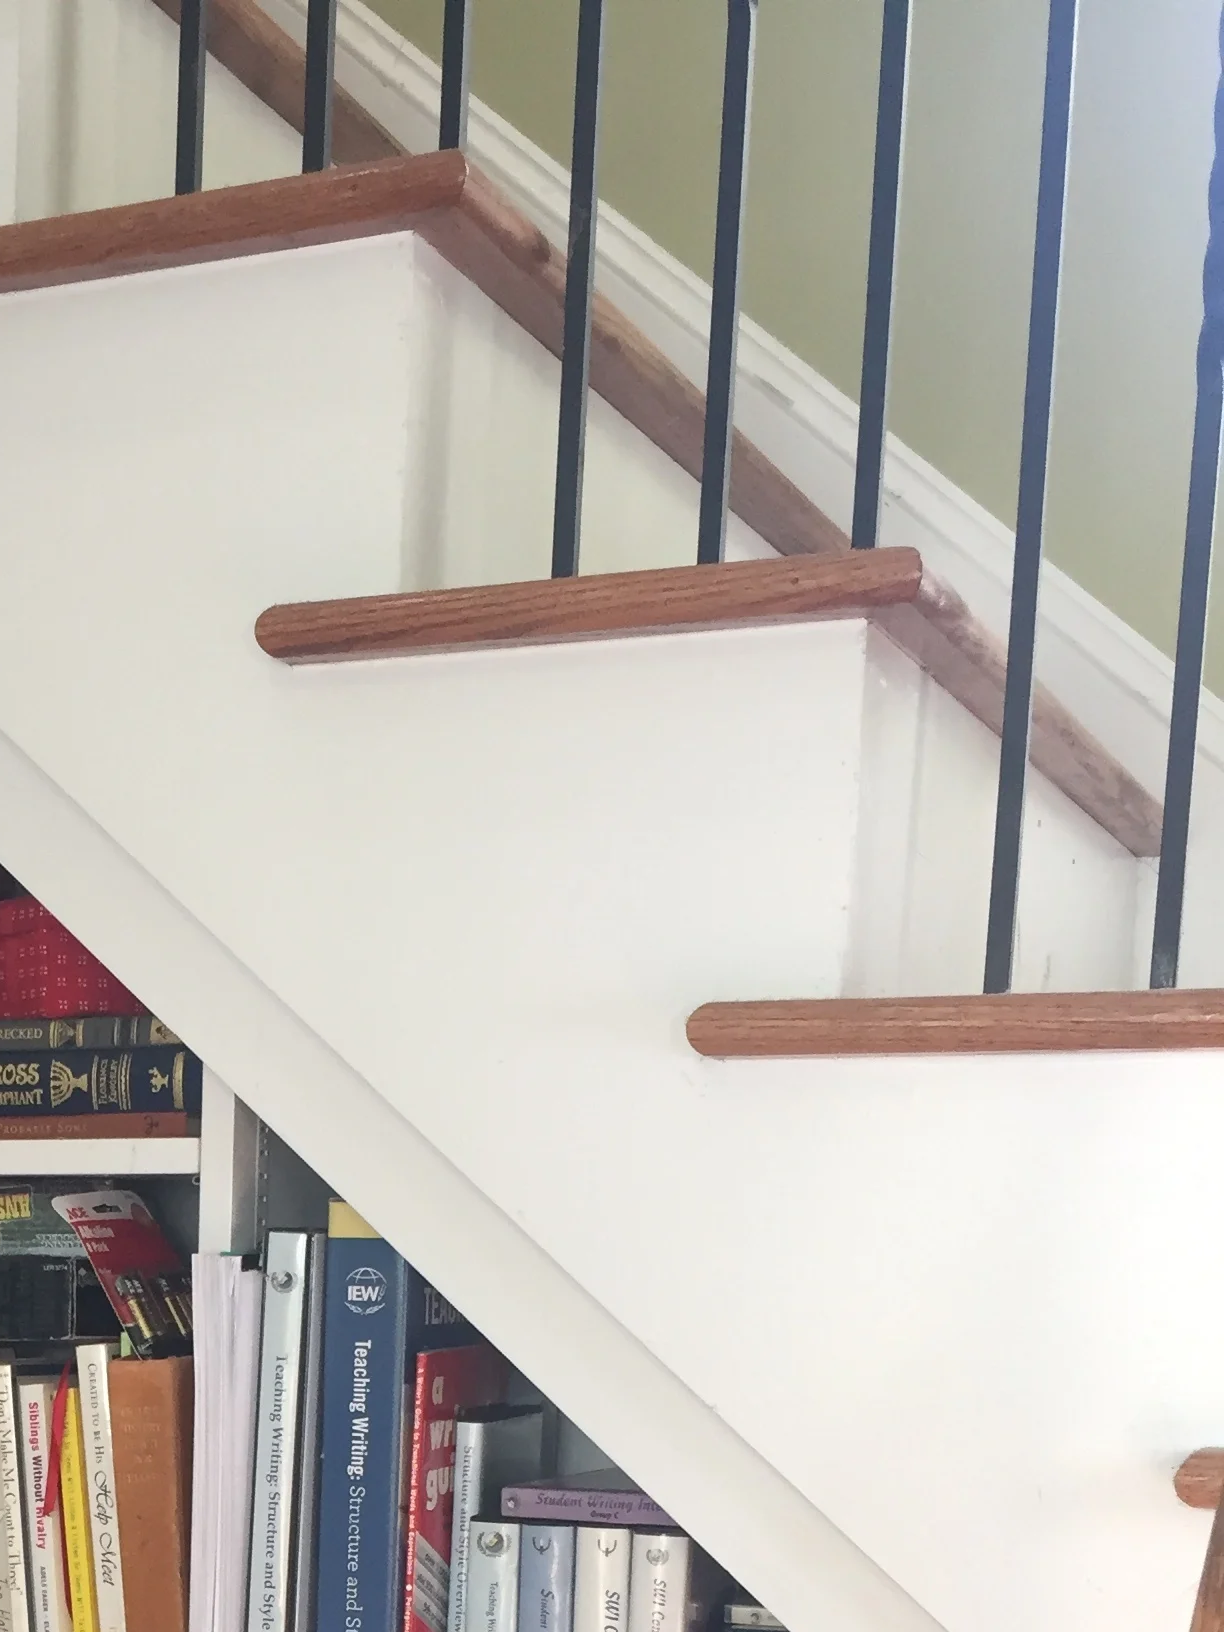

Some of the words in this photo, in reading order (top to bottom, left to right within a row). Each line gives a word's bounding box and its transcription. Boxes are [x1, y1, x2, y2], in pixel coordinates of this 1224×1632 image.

[347, 1285, 379, 1302] IEW
[269, 1353, 289, 1424] Teaching
[349, 1338, 372, 1413] Teaching
[28, 1400, 39, 1451] Siblings
[346, 1416, 370, 1481] Writing:
[31, 1455, 44, 1503] Without
[265, 1490, 281, 1558] Structure
[347, 1486, 366, 1572] Structure
[263, 1561, 276, 1589] and
[345, 1576, 363, 1612] and
[261, 1592, 276, 1631] Style
[604, 1588, 621, 1620] SWI
